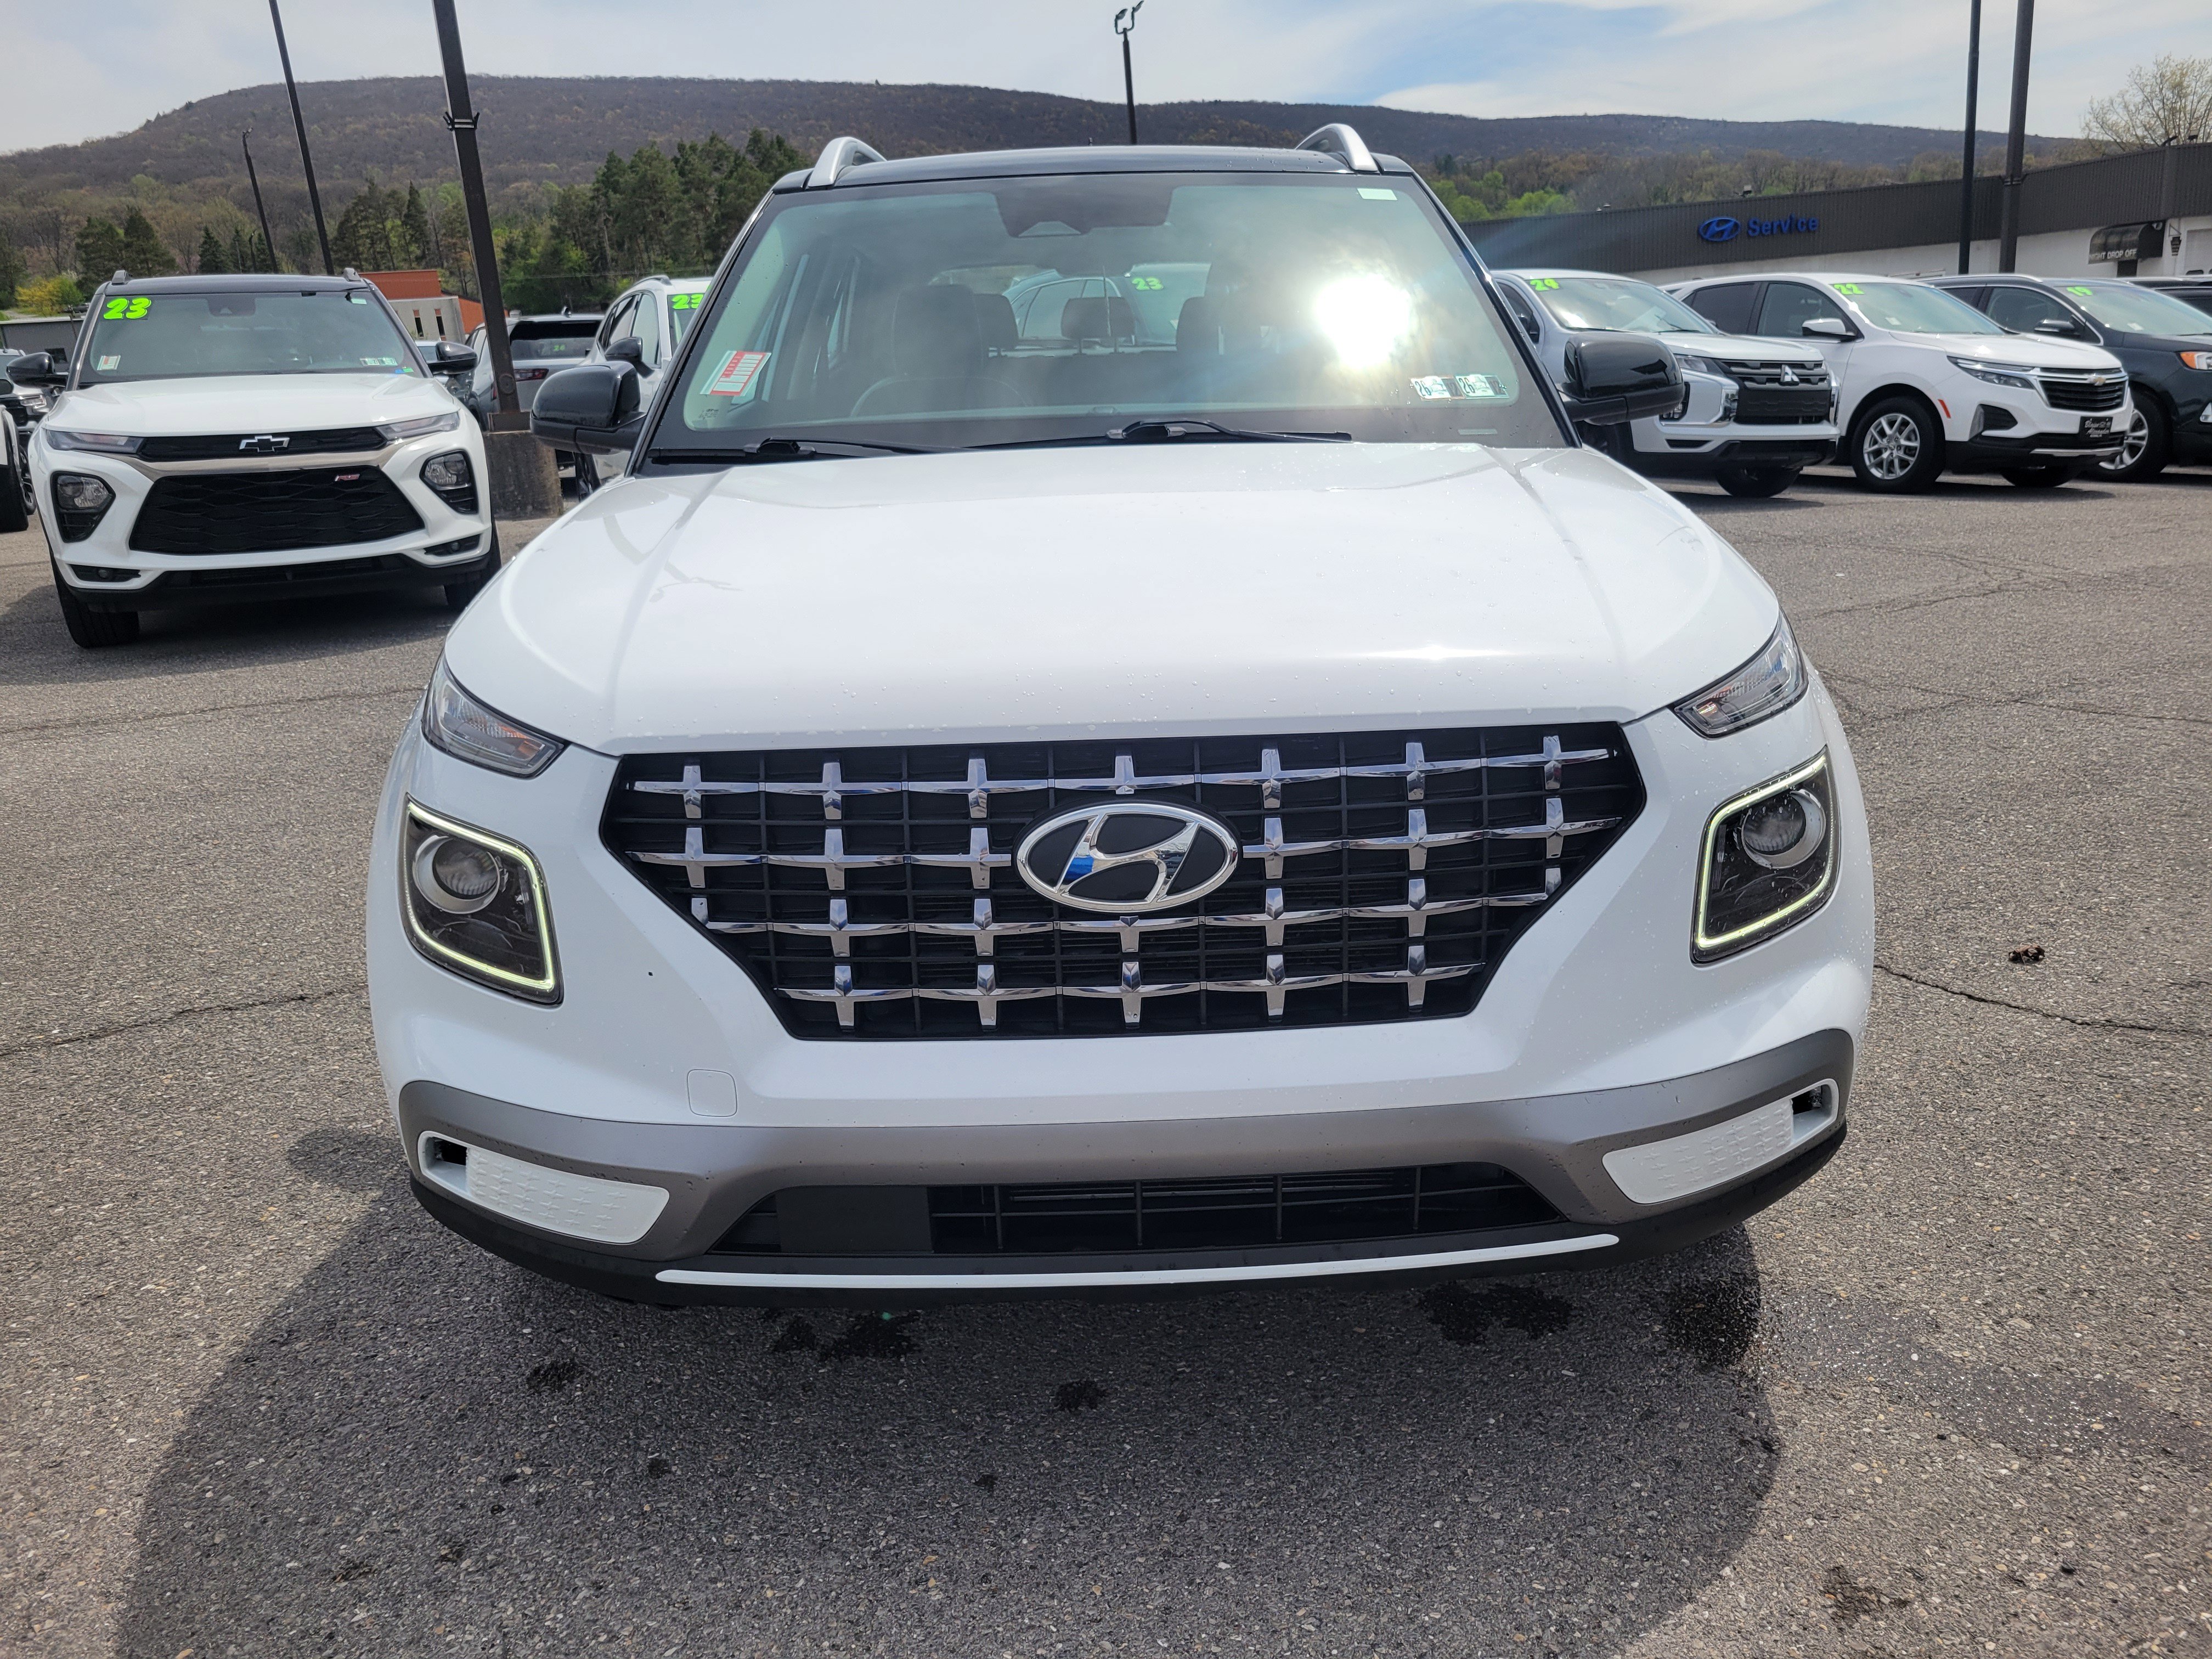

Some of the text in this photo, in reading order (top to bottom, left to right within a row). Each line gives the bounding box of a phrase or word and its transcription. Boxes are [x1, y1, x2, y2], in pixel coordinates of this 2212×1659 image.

[1748, 212, 1818, 236] Service
[2107, 250, 2123, 259] DROP
[2125, 249, 2137, 257] OFF
[1132, 278, 1163, 290] 23
[1834, 283, 1865, 295] 22
[2066, 286, 2092, 296] 19
[103, 297, 151, 319] 23
[1459, 377, 1475, 394] 26
